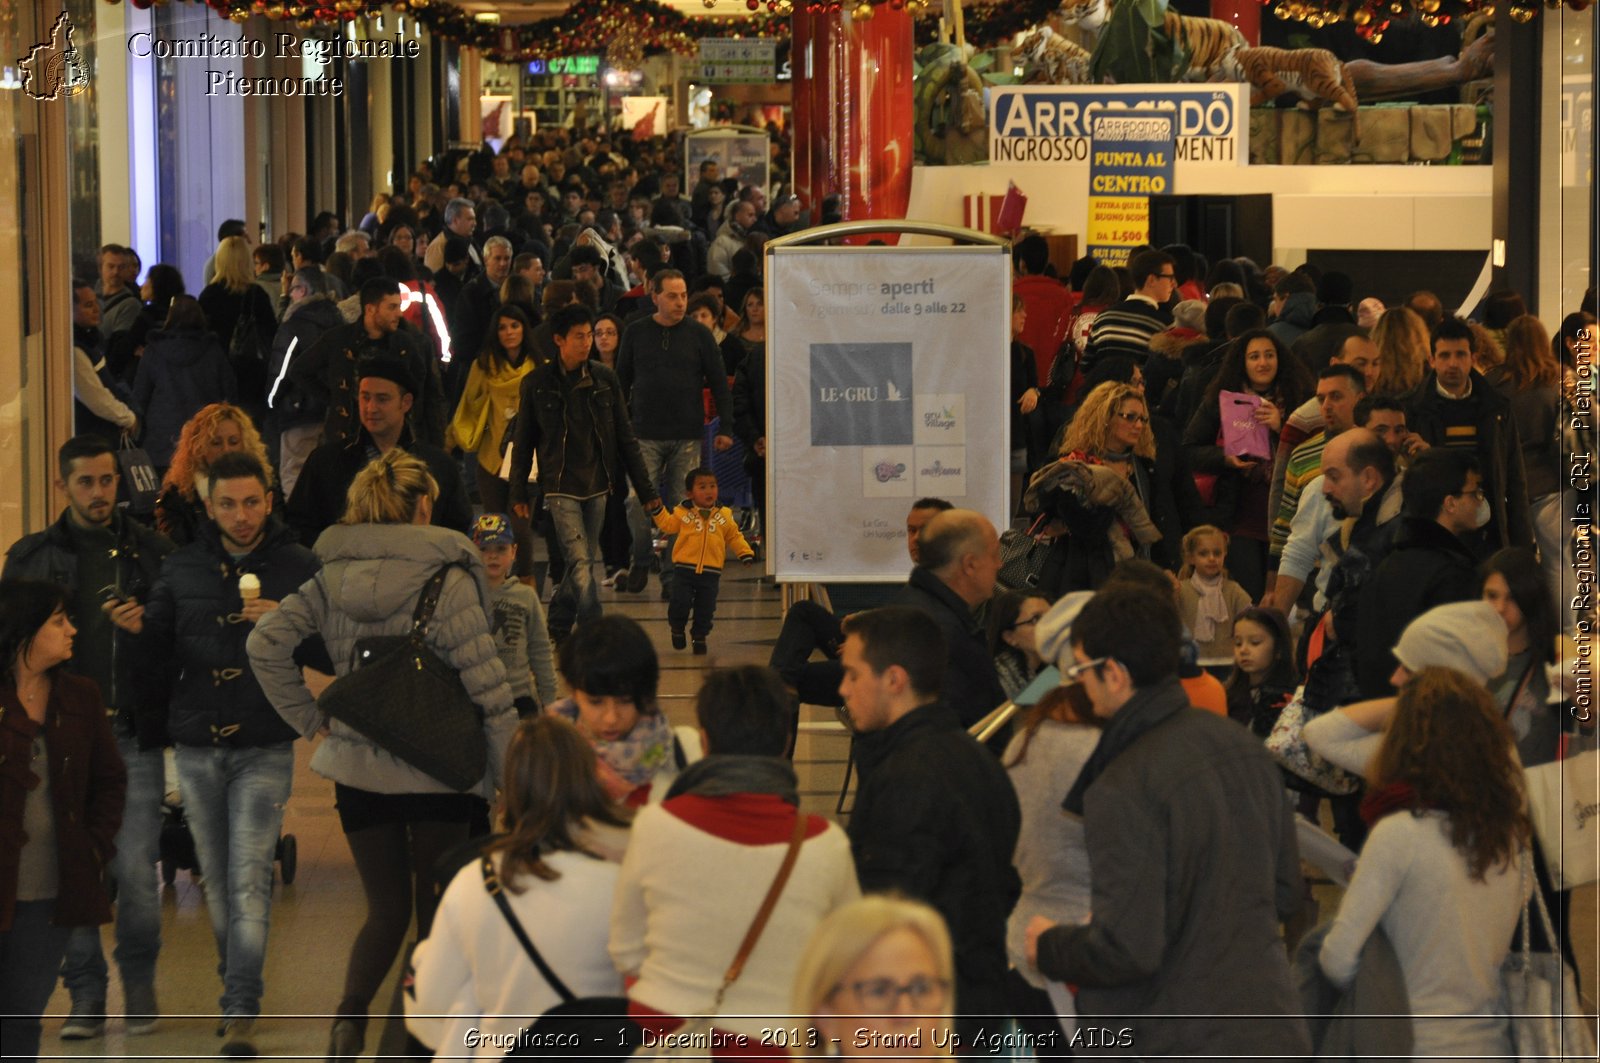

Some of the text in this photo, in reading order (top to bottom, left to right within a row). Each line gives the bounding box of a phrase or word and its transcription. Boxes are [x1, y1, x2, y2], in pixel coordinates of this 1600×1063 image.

[994, 137, 1088, 162] INGROSSO
[1094, 151, 1167, 167] PUNTA AL
[1093, 174, 1166, 193] CENTRO
[1094, 212, 1124, 221] BUONO
[1096, 231, 1108, 241] DA
[1111, 230, 1142, 242] 1.500
[809, 278, 935, 301] Sempre aperti
[880, 302, 911, 316] dalle
[914, 304, 922, 316] 9
[925, 302, 948, 315] alle
[951, 303, 967, 314] 22
[925, 418, 956, 430] village
